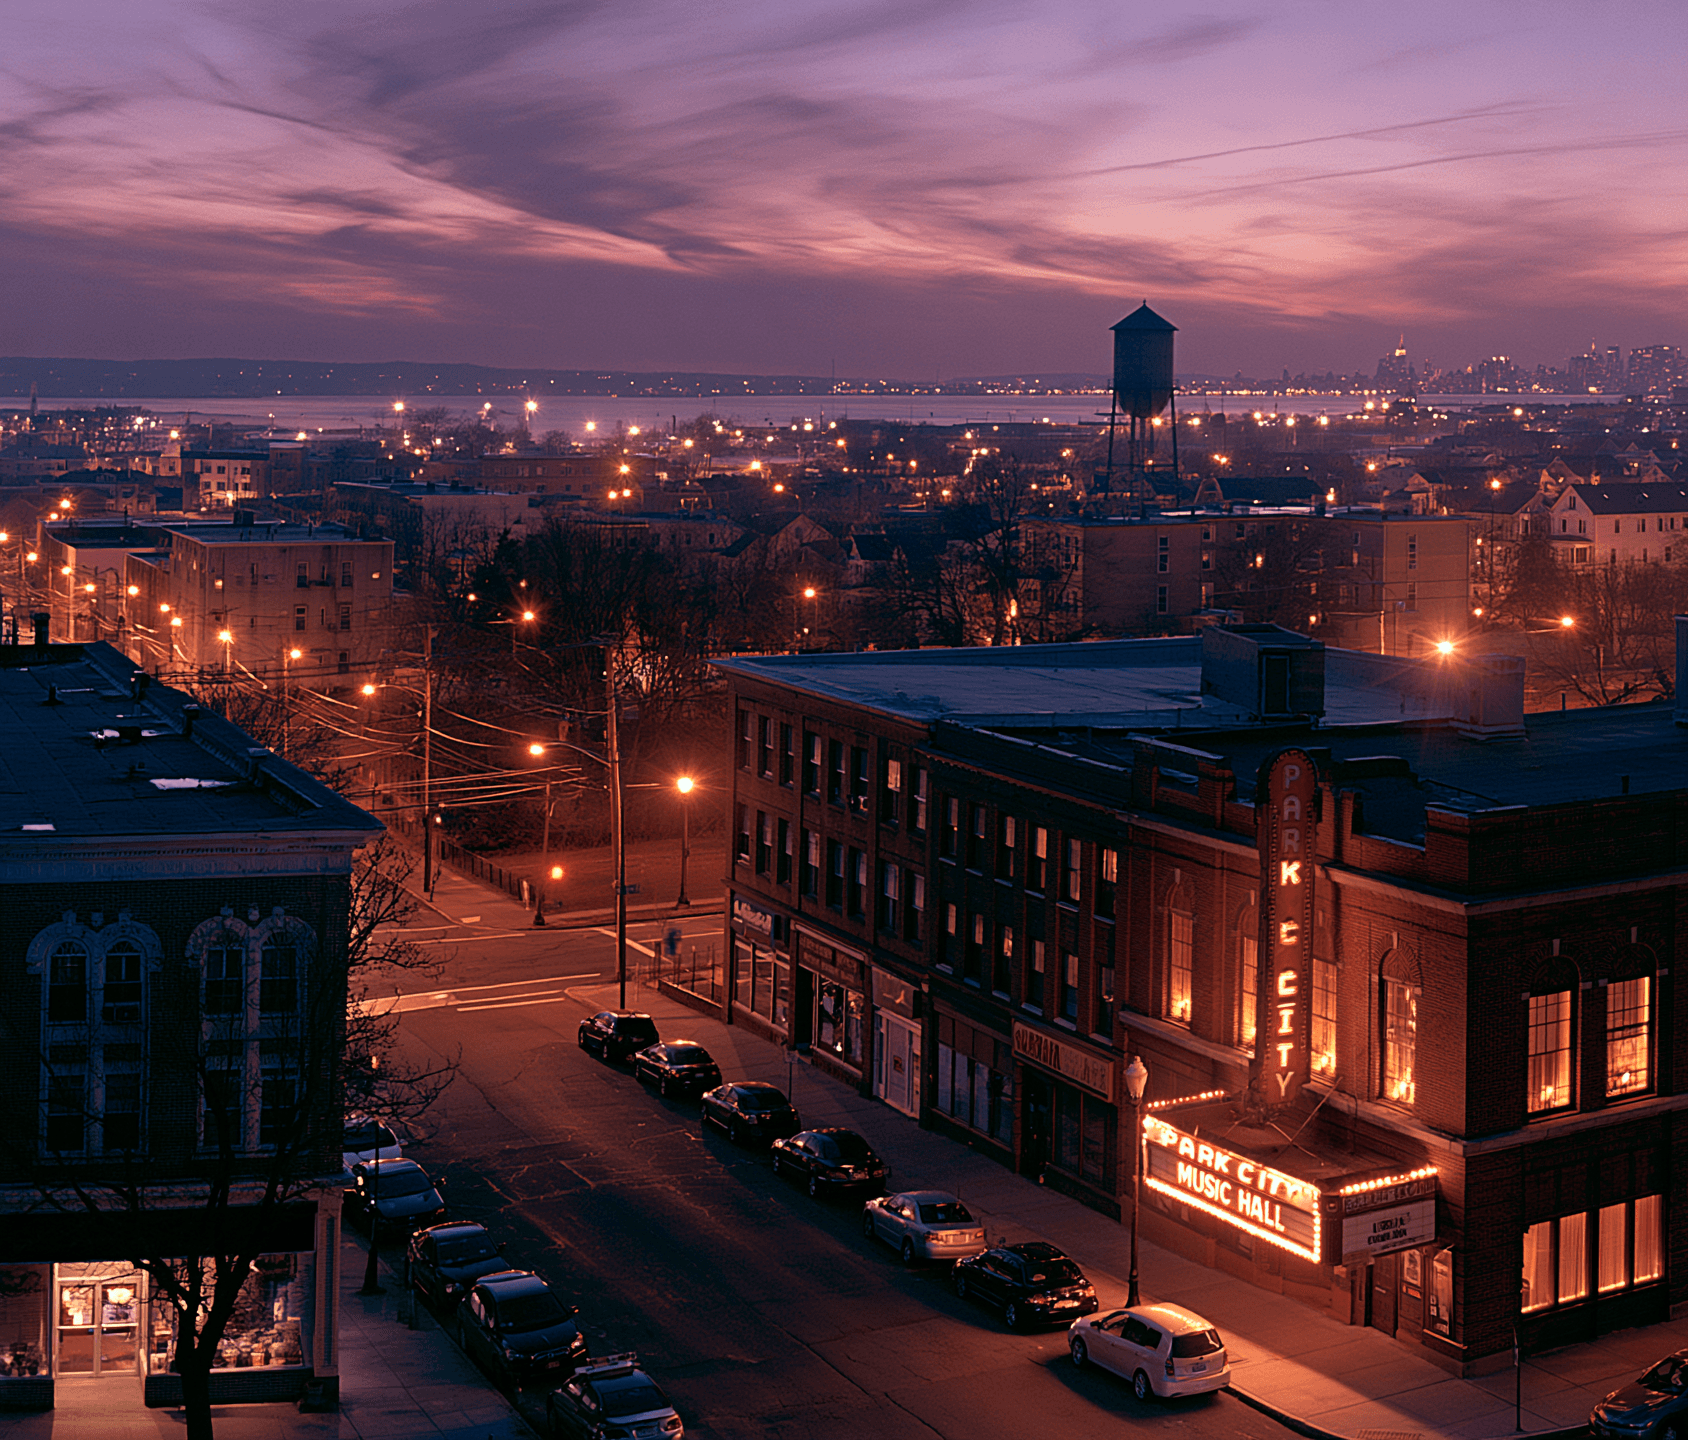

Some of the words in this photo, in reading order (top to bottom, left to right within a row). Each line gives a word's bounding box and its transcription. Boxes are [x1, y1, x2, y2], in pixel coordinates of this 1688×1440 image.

[1280, 763, 1302, 886] PARK
[1161, 1127, 1232, 1174] PARK
[1237, 1162, 1304, 1203] CITY
[1177, 1161, 1232, 1206] MUSIC
[1238, 1188, 1286, 1232] HALL
